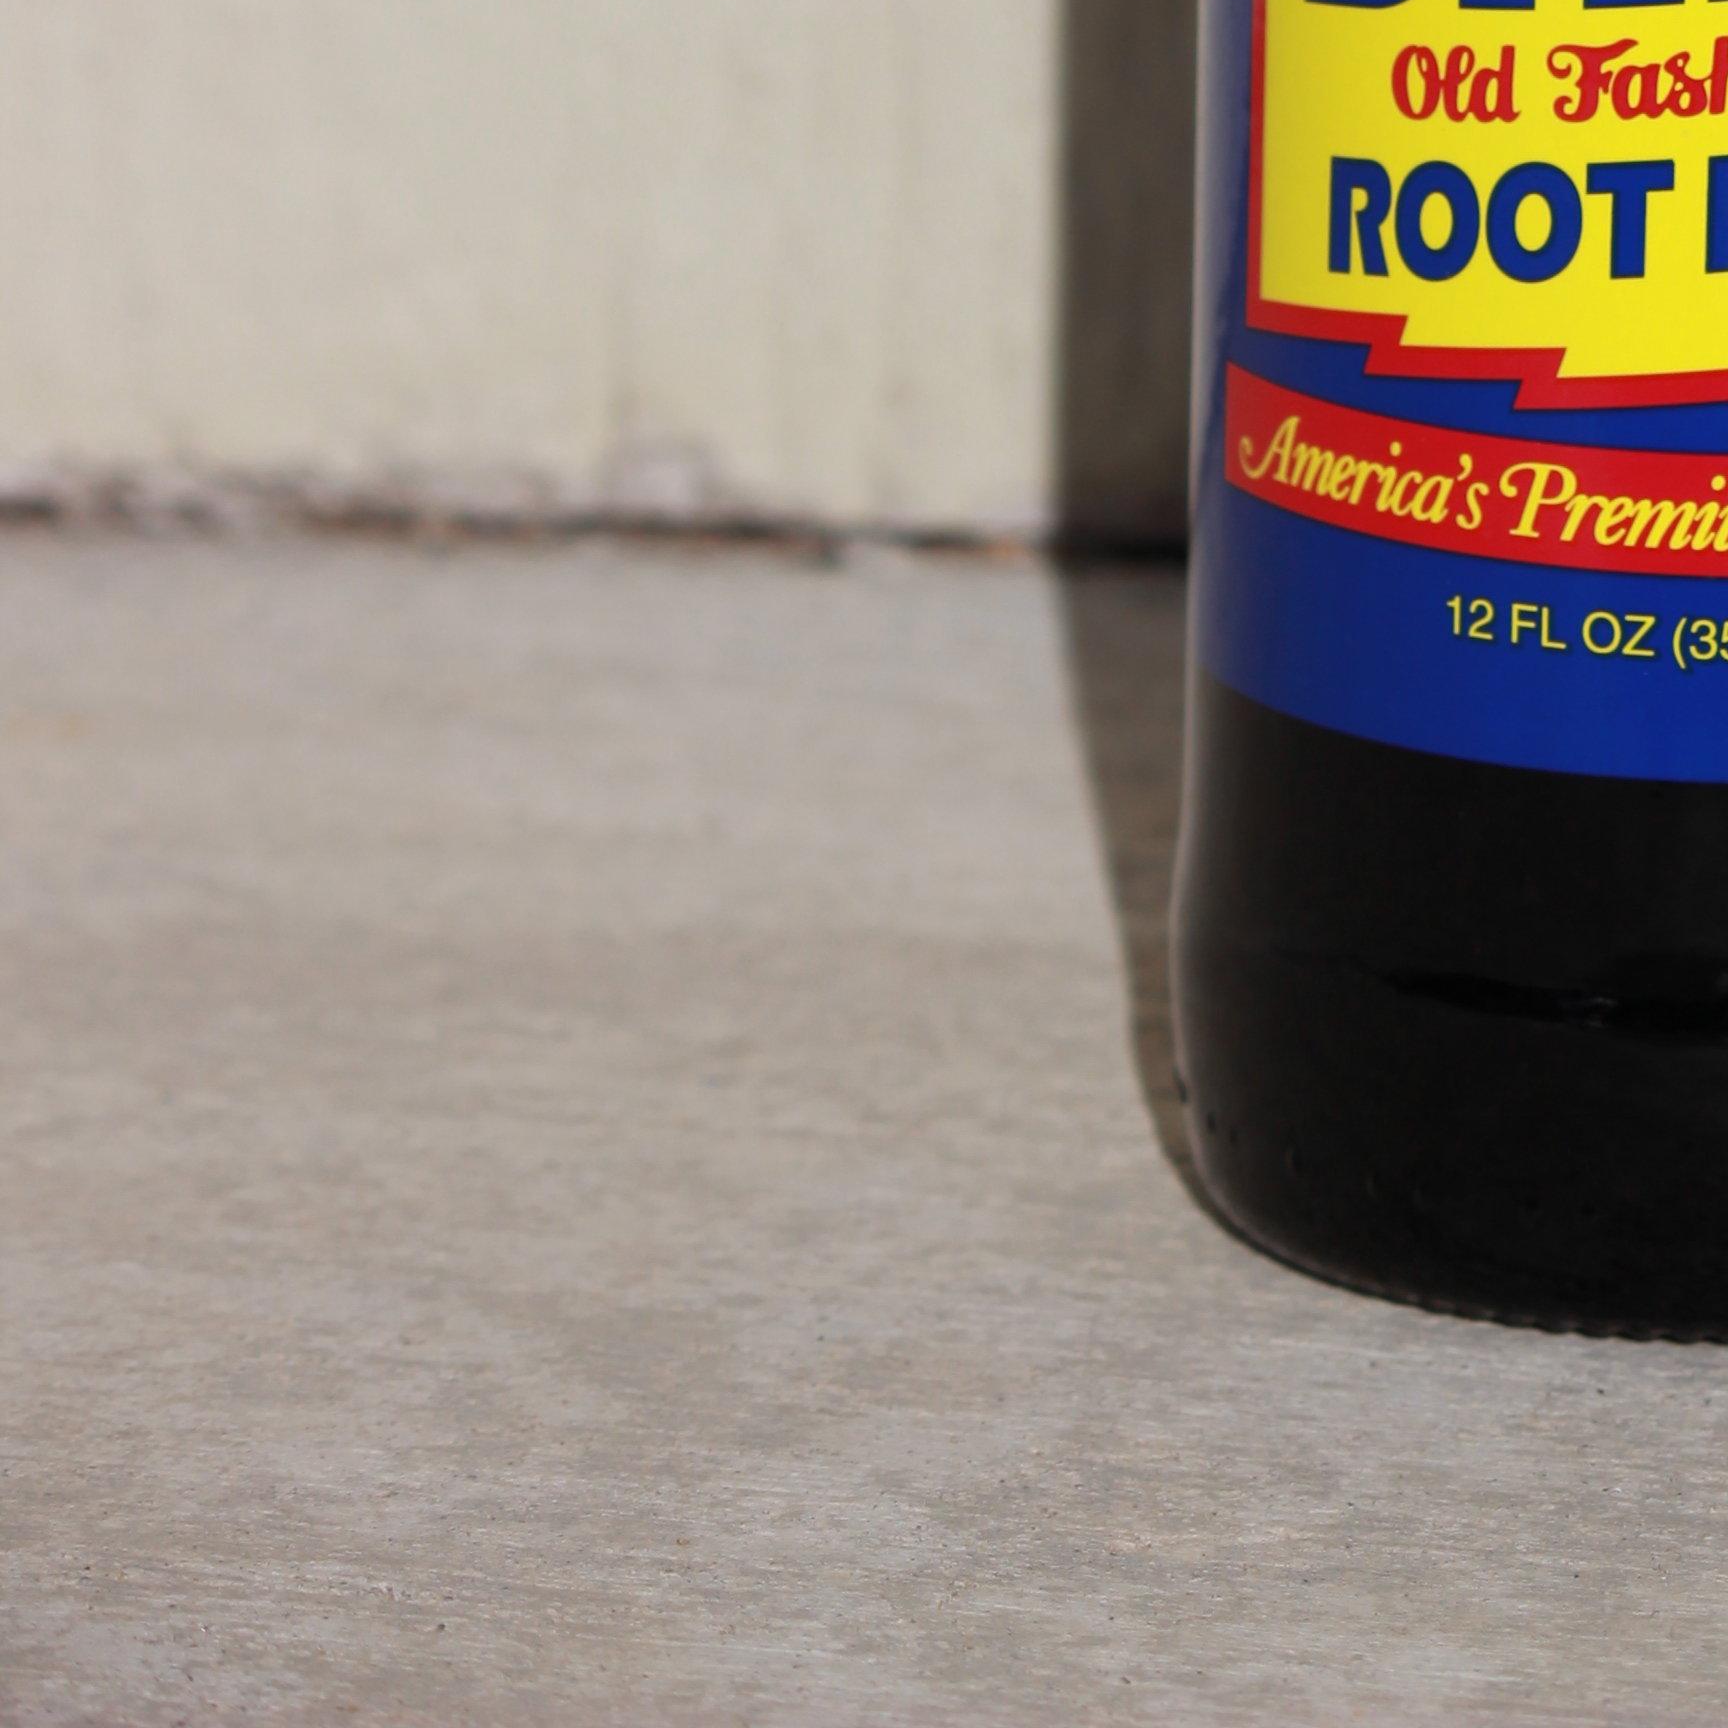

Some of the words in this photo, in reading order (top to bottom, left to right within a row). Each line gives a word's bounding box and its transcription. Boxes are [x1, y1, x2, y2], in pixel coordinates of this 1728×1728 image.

[1391, 43, 1521, 123] Old
[1327, 155, 1676, 284] ROOT
[1239, 415, 1490, 531] America's
[1445, 595, 1495, 642] 12
[1510, 603, 1567, 650] FL
[1582, 610, 1656, 657] OZ
